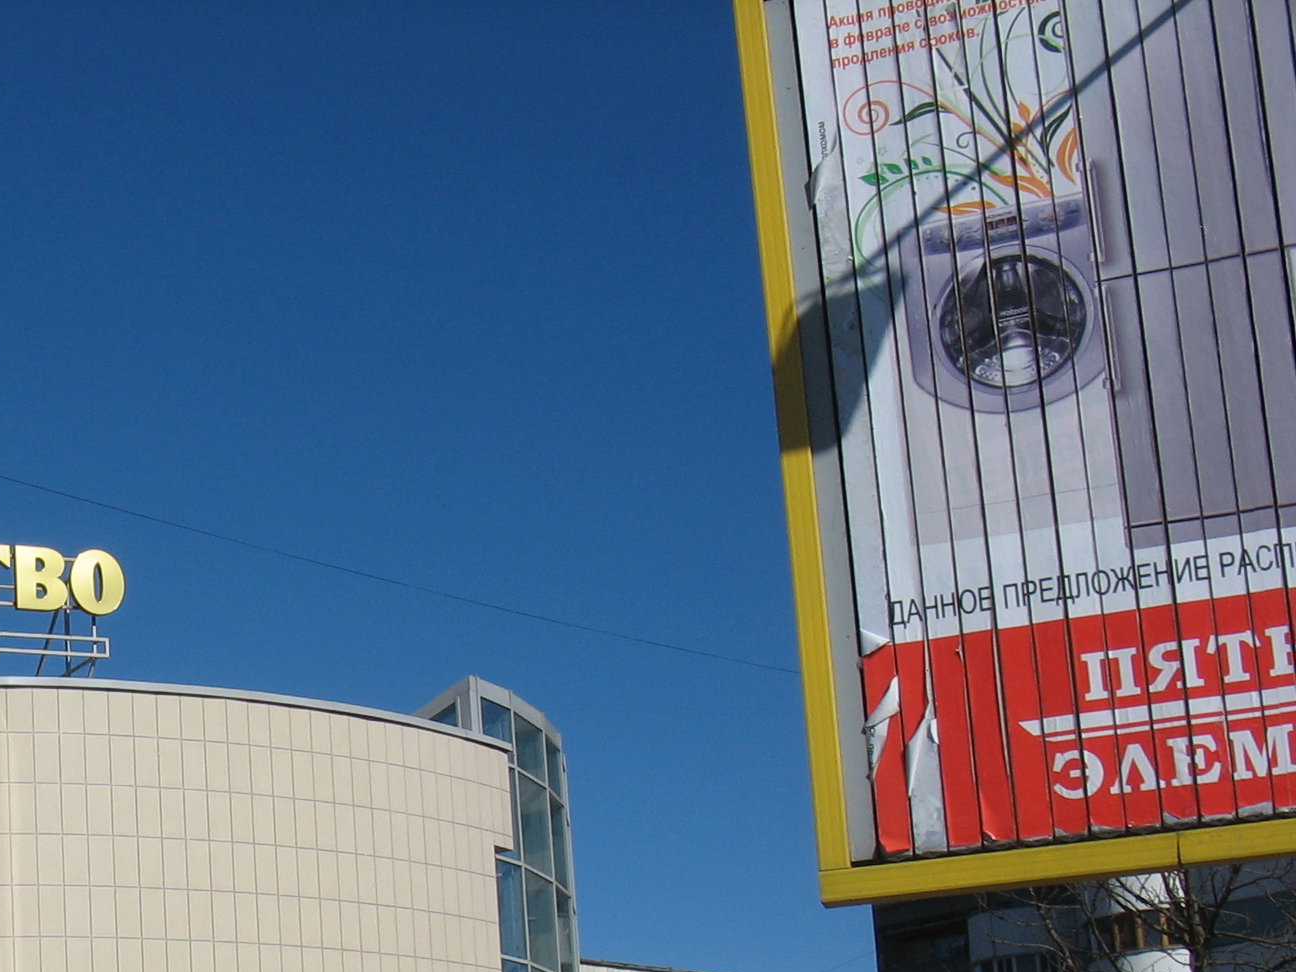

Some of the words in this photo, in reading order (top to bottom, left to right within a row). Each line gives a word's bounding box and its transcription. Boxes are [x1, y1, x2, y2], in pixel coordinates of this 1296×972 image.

[829, 9, 873, 29] Акция
[831, 38, 839, 49] в
[914, 18, 923, 29] с
[832, 41, 915, 69] продления
[889, 585, 995, 627] ДАННОЕ
[1003, 554, 1210, 609] ПРЕДЛОЖЕНИЕ
[1219, 542, 1296, 578] РАСП
